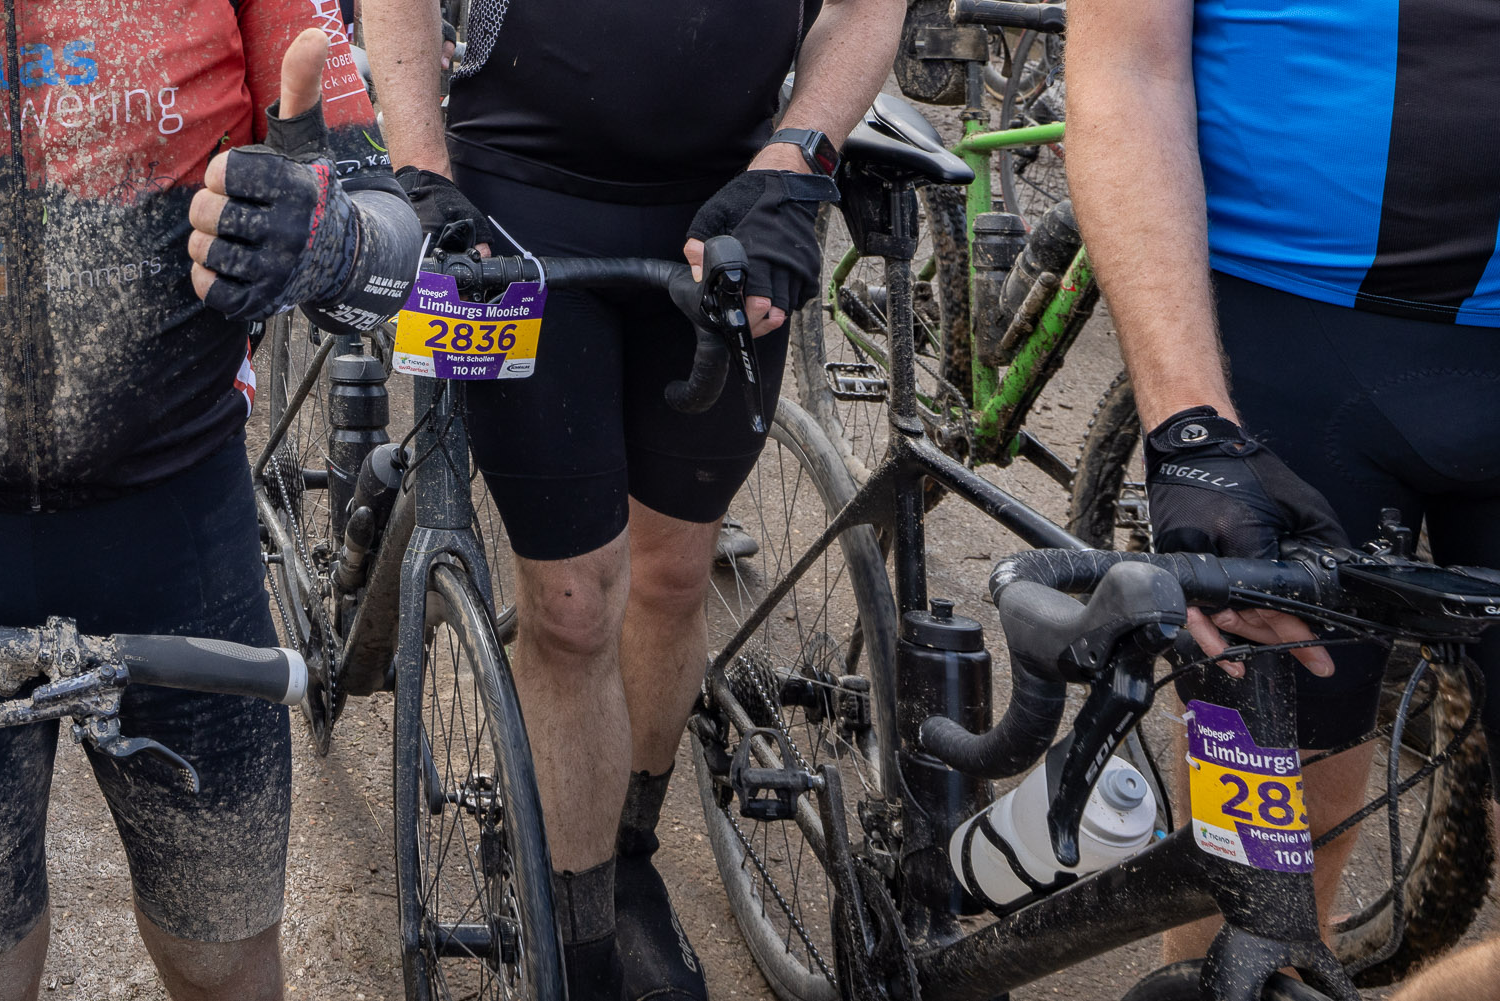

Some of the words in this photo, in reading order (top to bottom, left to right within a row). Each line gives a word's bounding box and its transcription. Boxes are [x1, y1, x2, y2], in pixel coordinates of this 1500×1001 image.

[44, 254, 162, 294] Timmers
[417, 286, 444, 299] Vebego
[419, 296, 483, 319] Limburgs
[486, 306, 530, 318] Mooiste
[425, 319, 518, 352] 2836
[446, 354, 465, 362] Mark
[466, 355, 495, 363] Schollen
[452, 366, 468, 375] 110
[470, 366, 486, 376] KM
[1159, 462, 1239, 489] ROGELLI
[1198, 724, 1228, 741] Vebego
[1204, 738, 1293, 774] Limburgs
[1250, 828, 1299, 844] Mechiel
[1275, 849, 1302, 865] 110
